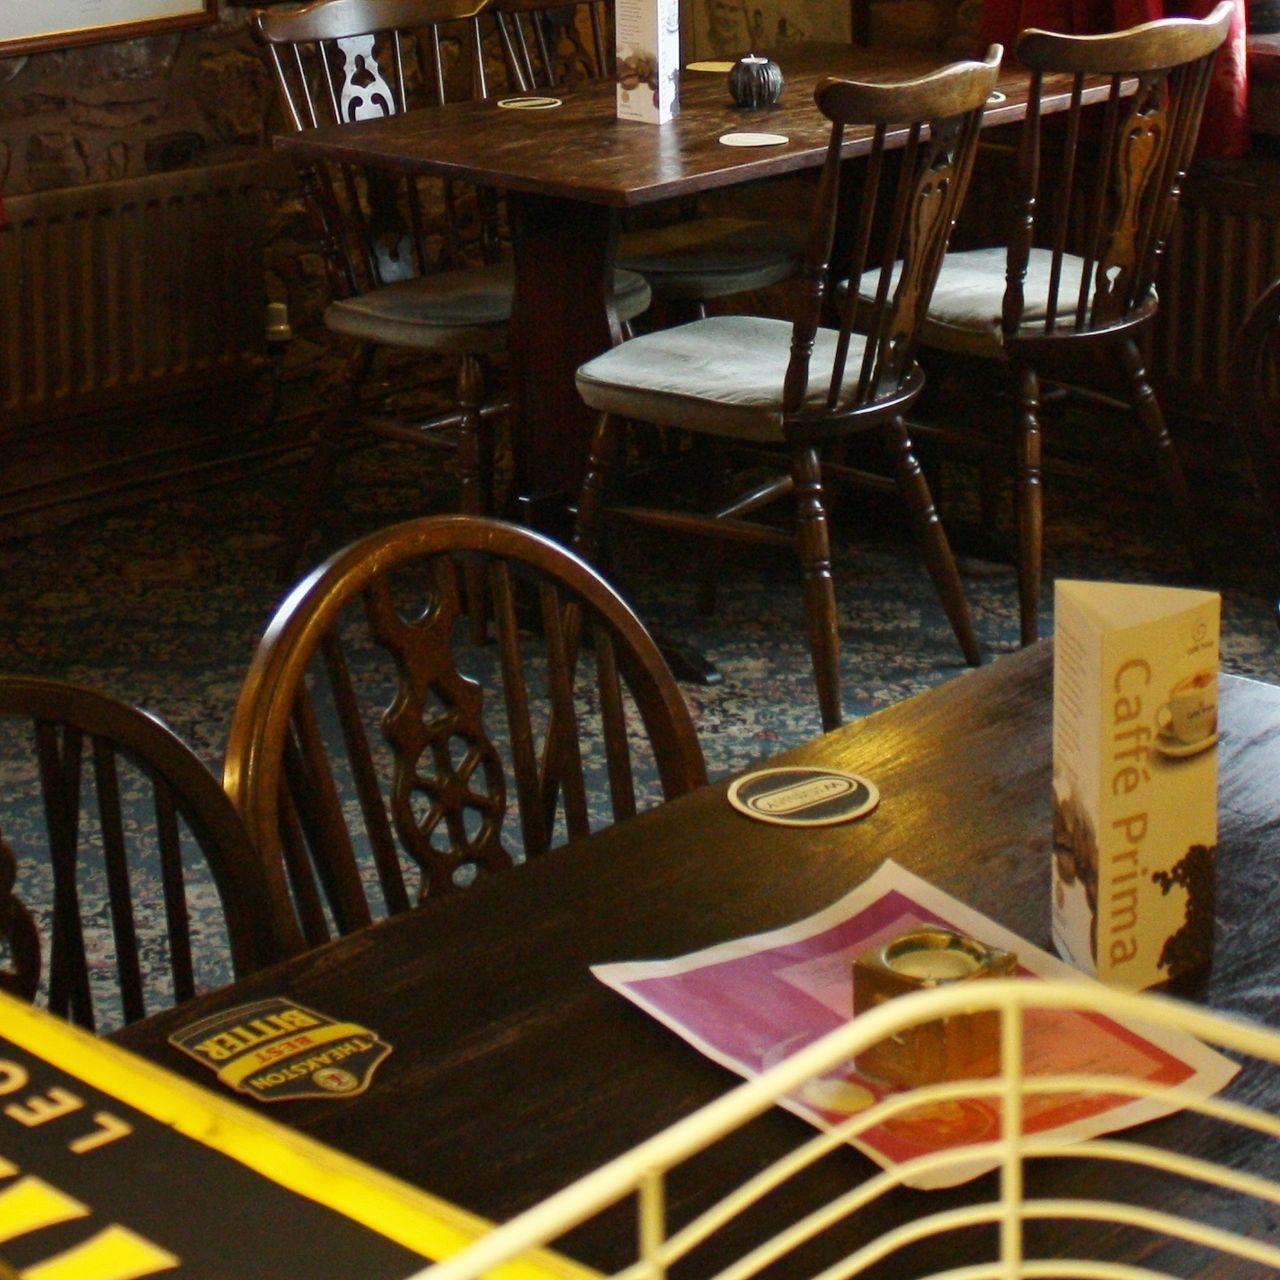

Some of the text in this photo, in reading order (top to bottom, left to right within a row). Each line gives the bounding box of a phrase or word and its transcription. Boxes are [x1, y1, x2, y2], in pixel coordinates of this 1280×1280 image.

[1109, 657, 1152, 968] Caffé Prima
[192, 1008, 323, 1061] BITTER
[257, 1035, 317, 1065] BEST
[249, 1038, 374, 1091] THEAKSTON
